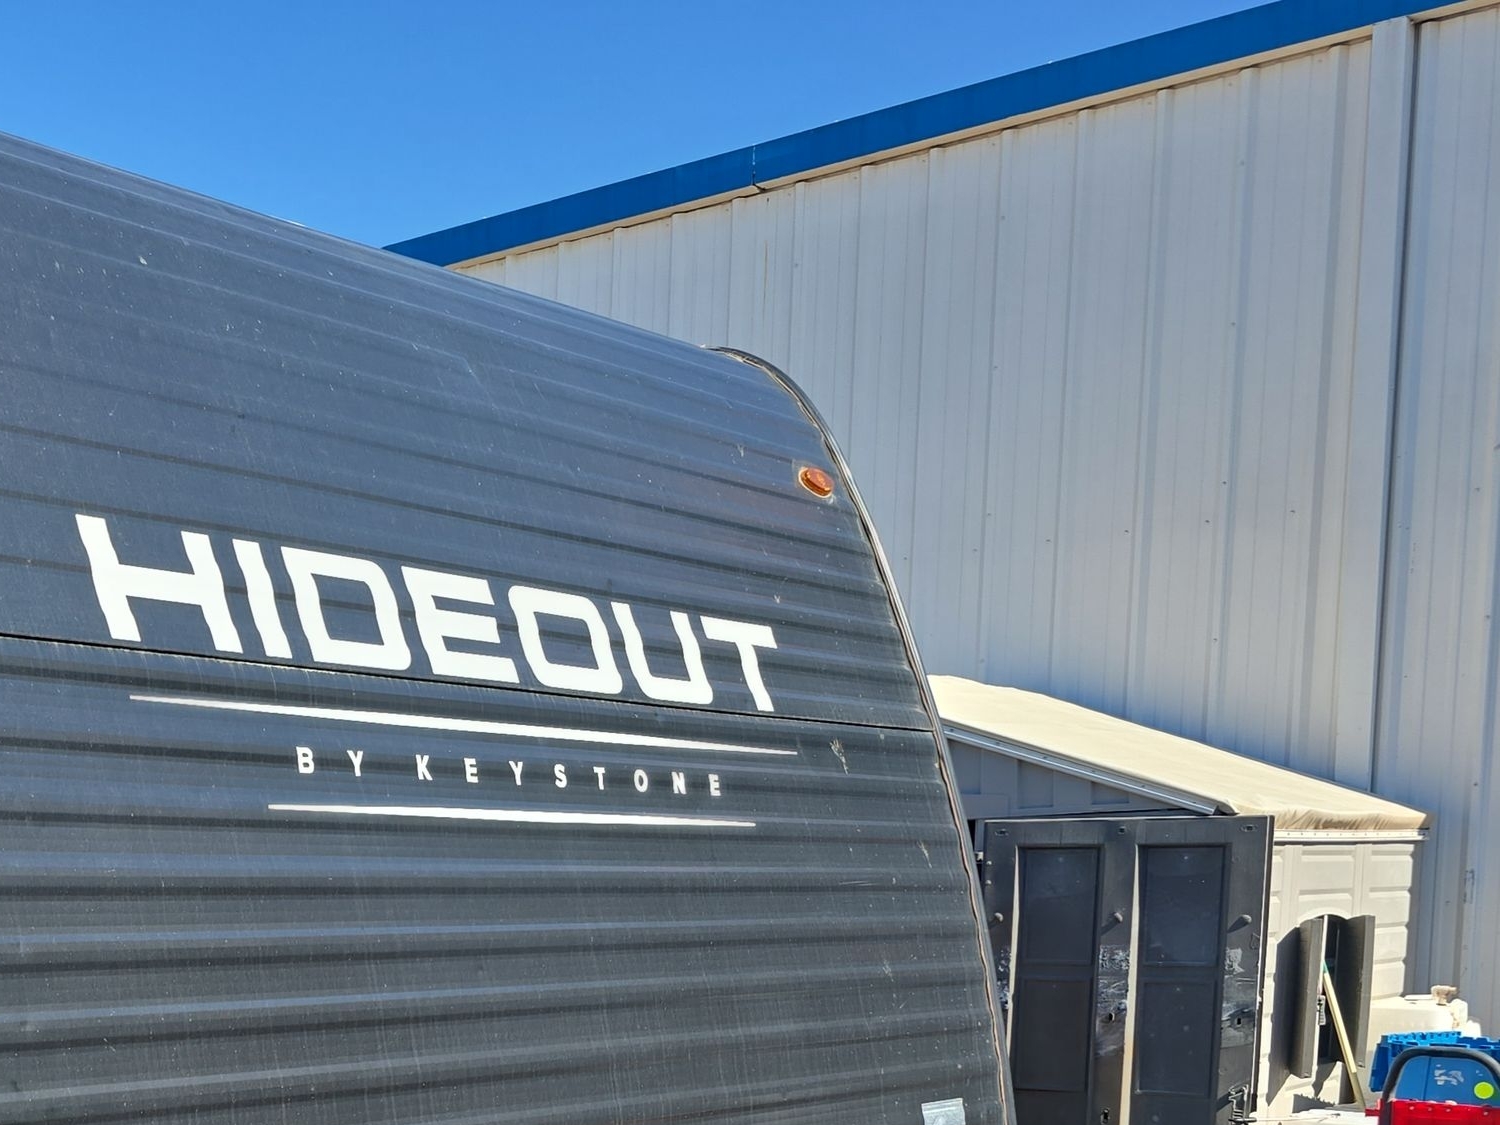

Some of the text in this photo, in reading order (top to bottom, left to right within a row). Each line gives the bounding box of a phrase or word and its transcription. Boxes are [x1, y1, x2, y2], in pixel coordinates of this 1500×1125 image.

[74, 513, 778, 712] HIDEOUT
[295, 746, 722, 797] BY KEYSTONE
